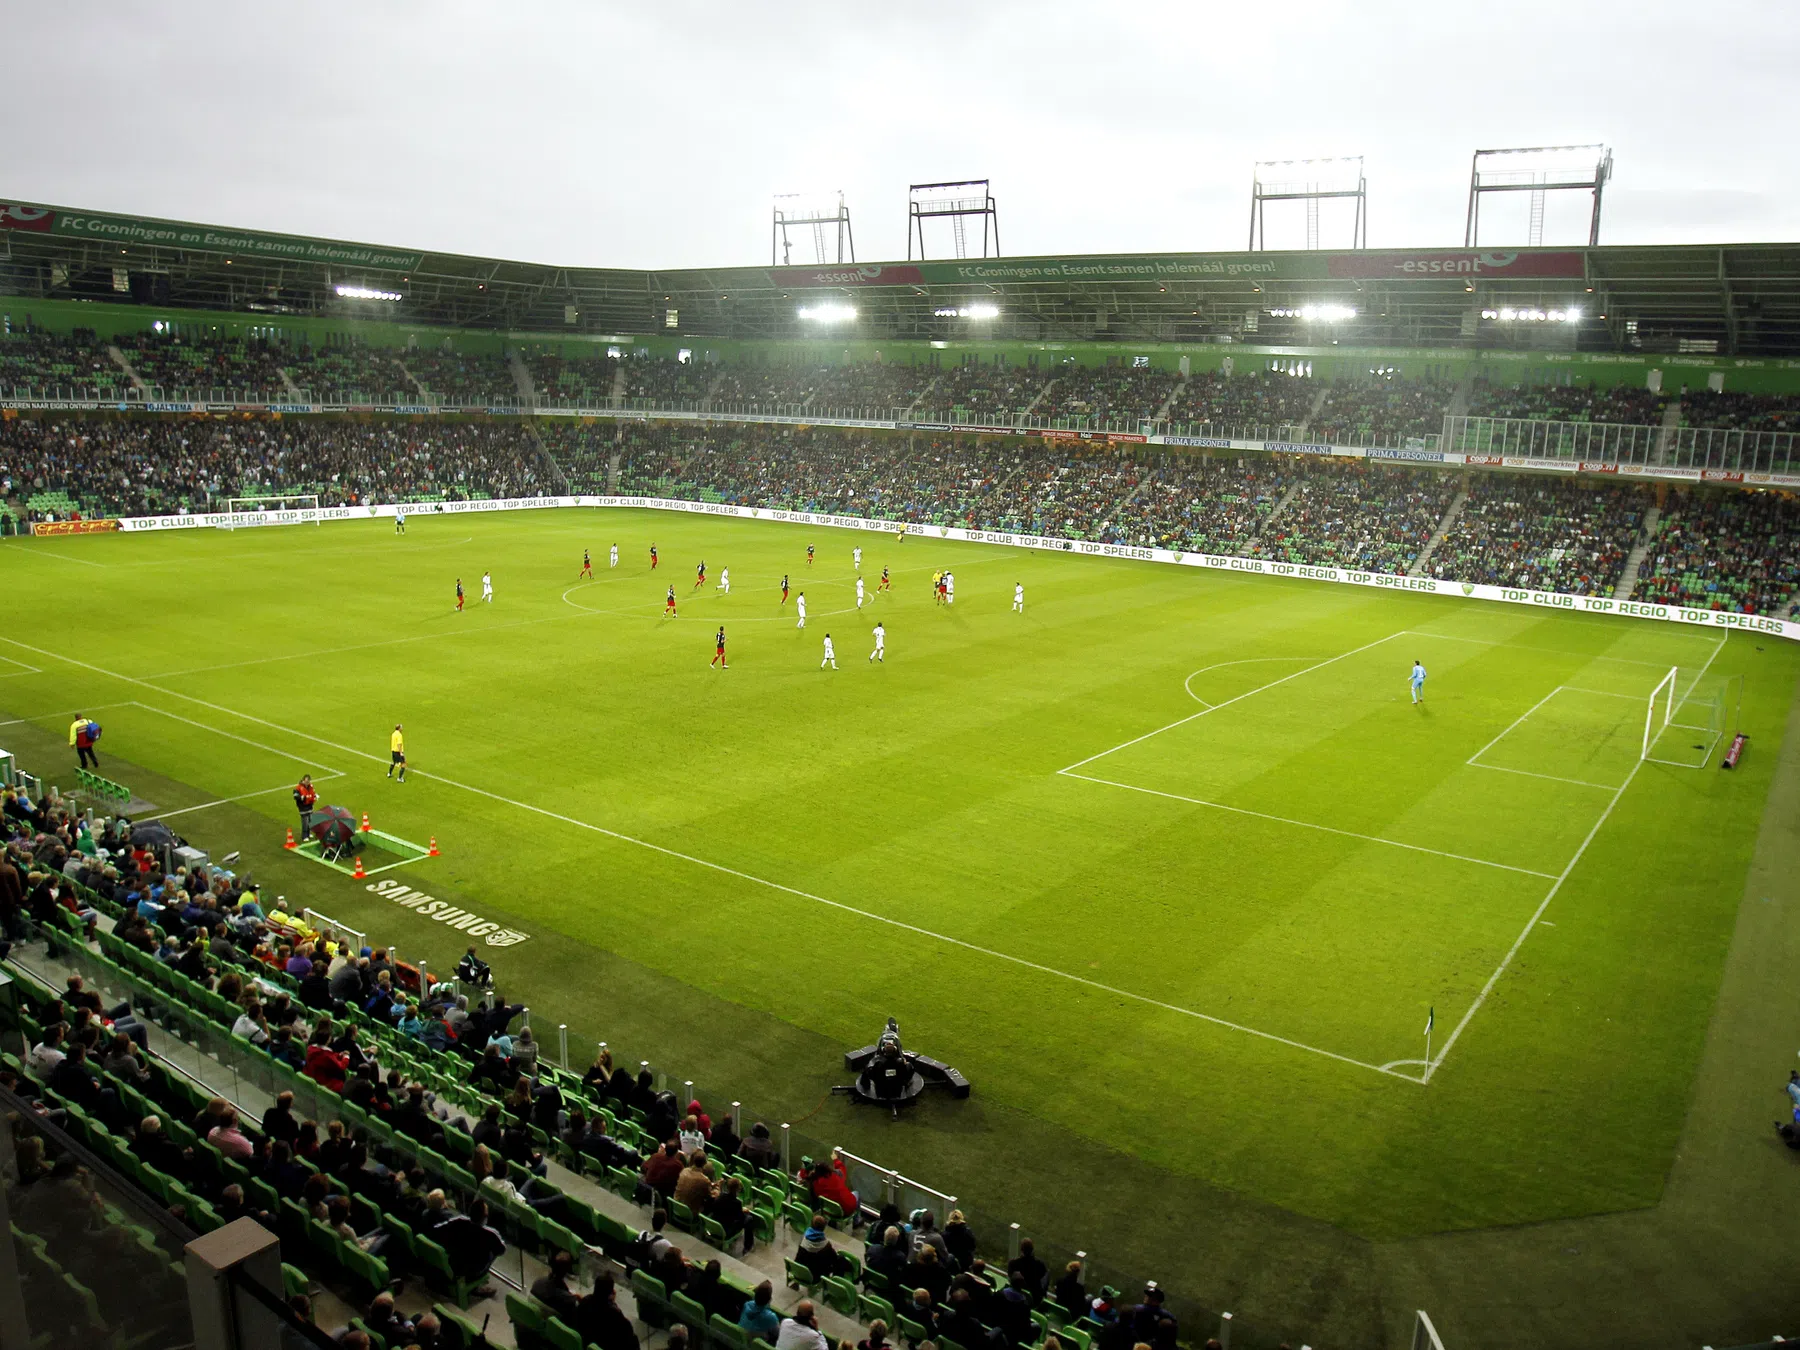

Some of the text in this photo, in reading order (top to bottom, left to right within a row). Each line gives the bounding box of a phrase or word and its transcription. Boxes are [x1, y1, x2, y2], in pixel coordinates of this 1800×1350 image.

[62, 217, 85, 230] FC
[87, 220, 177, 243] Groningen
[180, 232, 200, 242] en
[204, 234, 254, 249] Essent
[256, 241, 304, 256] samen
[372, 252, 414, 267] groen!
[958, 267, 974, 278] FC
[975, 265, 1041, 280] Groningen
[1044, 268, 1059, 277] en
[1062, 264, 1106, 276] Essent
[1107, 264, 1152, 275] samen
[1227, 261, 1276, 276] groen!
[1395, 257, 1484, 273] essent
[812, 269, 863, 284] essent
[32, 402, 49, 410] NAAR
[1165, 437, 1229, 448] PRIMA PERSONEEL
[1266, 443, 1331, 454] WWW.PRIMA.NL
[1368, 449, 1443, 462] PRIMA PERSONEEL
[1470, 455, 1500, 464] coop.nl
[1527, 460, 1576, 469] supermarkten
[1583, 462, 1615, 472] coop.nl
[1645, 468, 1698, 477] supermarkten
[1750, 474, 1770, 482] coop
[396, 506, 415, 514] TOP
[450, 503, 467, 511] TOP
[522, 499, 559, 507] SPELERS
[706, 506, 739, 515] SPELERS
[131, 519, 157, 528] TOP
[204, 516, 227, 525] TOP
[276, 512, 297, 520] TOP
[772, 512, 787, 520] TOP
[816, 516, 832, 525] TOP
[865, 521, 881, 529] TOP
[884, 522, 924, 534] SPEERS
[965, 531, 984, 541] TOP
[1019, 537, 1038, 546] TOP
[1080, 543, 1101, 553] TOP
[1104, 546, 1153, 559] SPELERS
[1204, 556, 1436, 591] TOP CLUB, TOP REGIO, TOP SPELERS
[1500, 589, 1784, 633] TOP CLUB, TOP REGIO, TOP SPELERS
[366, 880, 500, 936] SAMSUNG
[913, 1235, 926, 1251] 5
